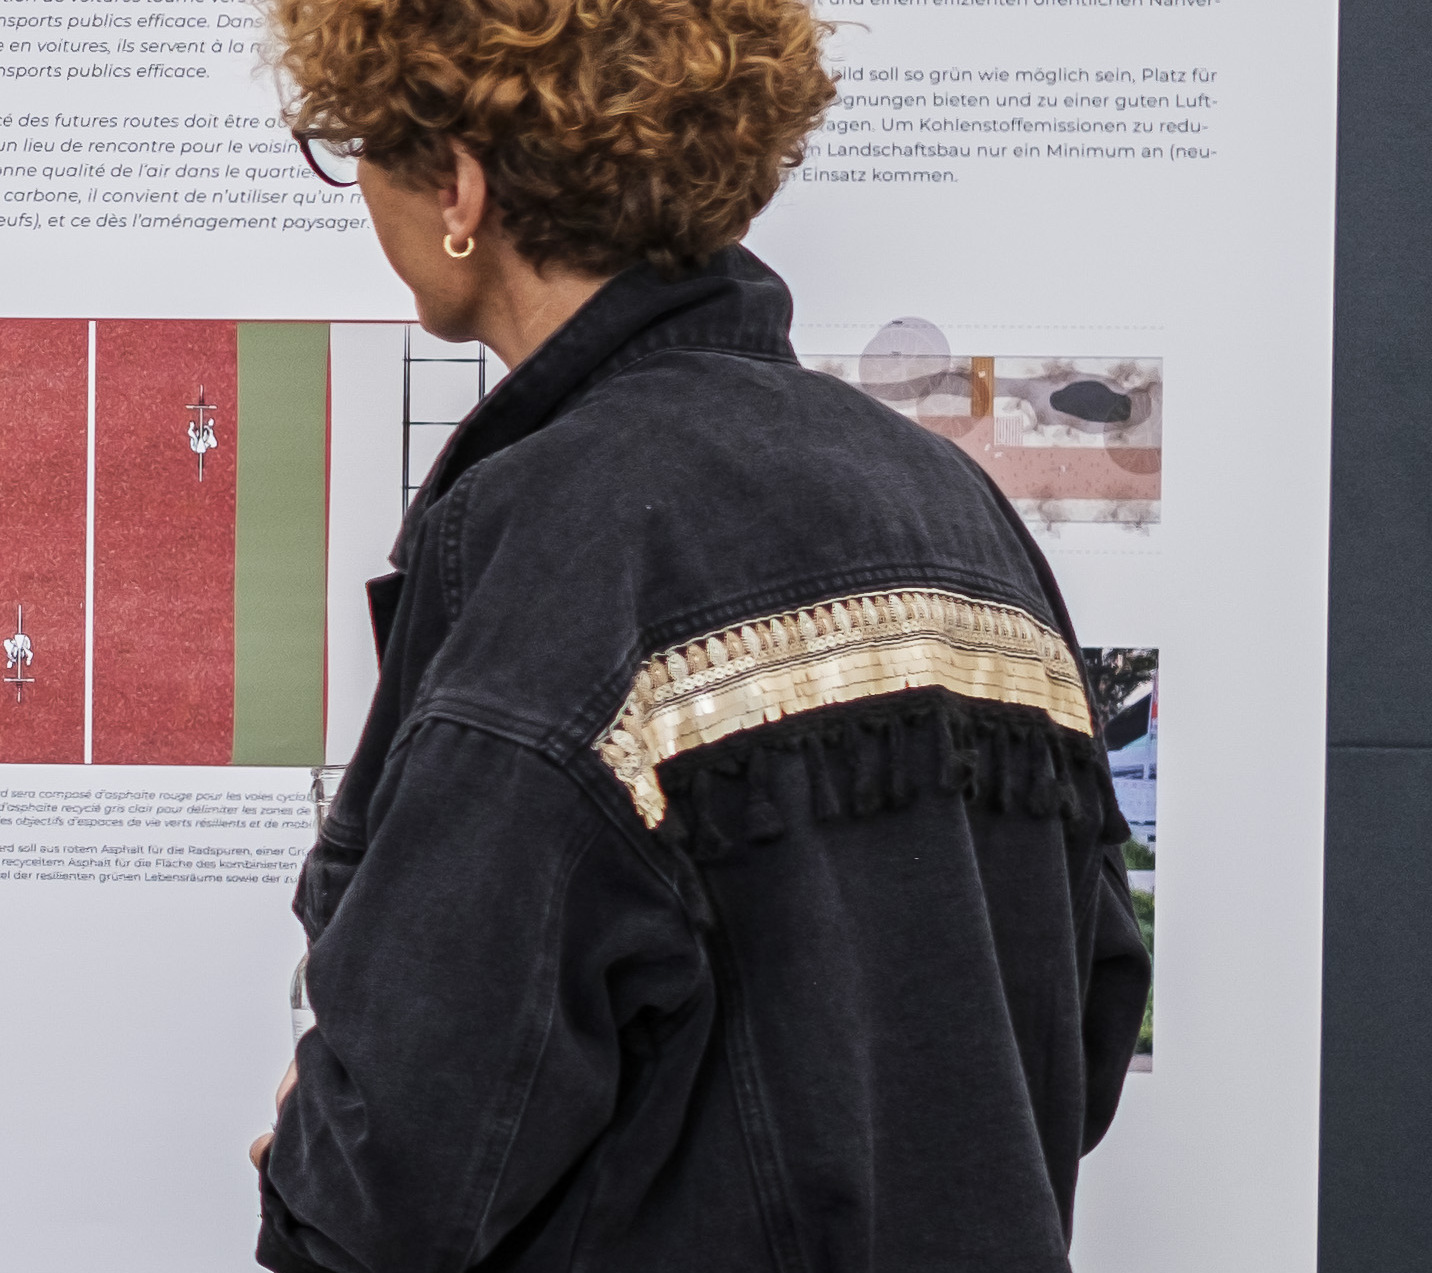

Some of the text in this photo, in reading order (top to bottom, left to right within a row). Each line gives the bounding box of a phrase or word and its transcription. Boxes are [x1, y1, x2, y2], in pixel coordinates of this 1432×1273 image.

[66, 12, 133, 32] publics
[136, 12, 211, 29] efficace.
[216, 10, 264, 29] Dans
[9, 41, 32, 53] en
[36, 37, 112, 56] voitures,
[116, 37, 136, 54] ils
[139, 39, 207, 54] servent
[210, 38, 224, 54] à
[227, 38, 245, 54] la
[66, 62, 132, 82] publics
[136, 62, 210, 79] efficace.
[868, 65, 1218, 87] soll so grün wie möglich sein, Platz für
[17, 112, 50, 128] des
[54, 112, 119, 129] futures
[122, 115, 180, 129] routes
[183, 113, 220, 129] doit
[223, 113, 261, 129] être
[827, 141, 1218, 163] Landschaftsbau nur ein Minimum an (neu-
[800, 163, 960, 184] Einsatz kommen.
[47, 215, 67, 228] et
[69, 216, 92, 228] ce
[95, 212, 128, 228] dès
[131, 212, 278, 232] l'aménagement
[281, 211, 373, 233] paysager.
